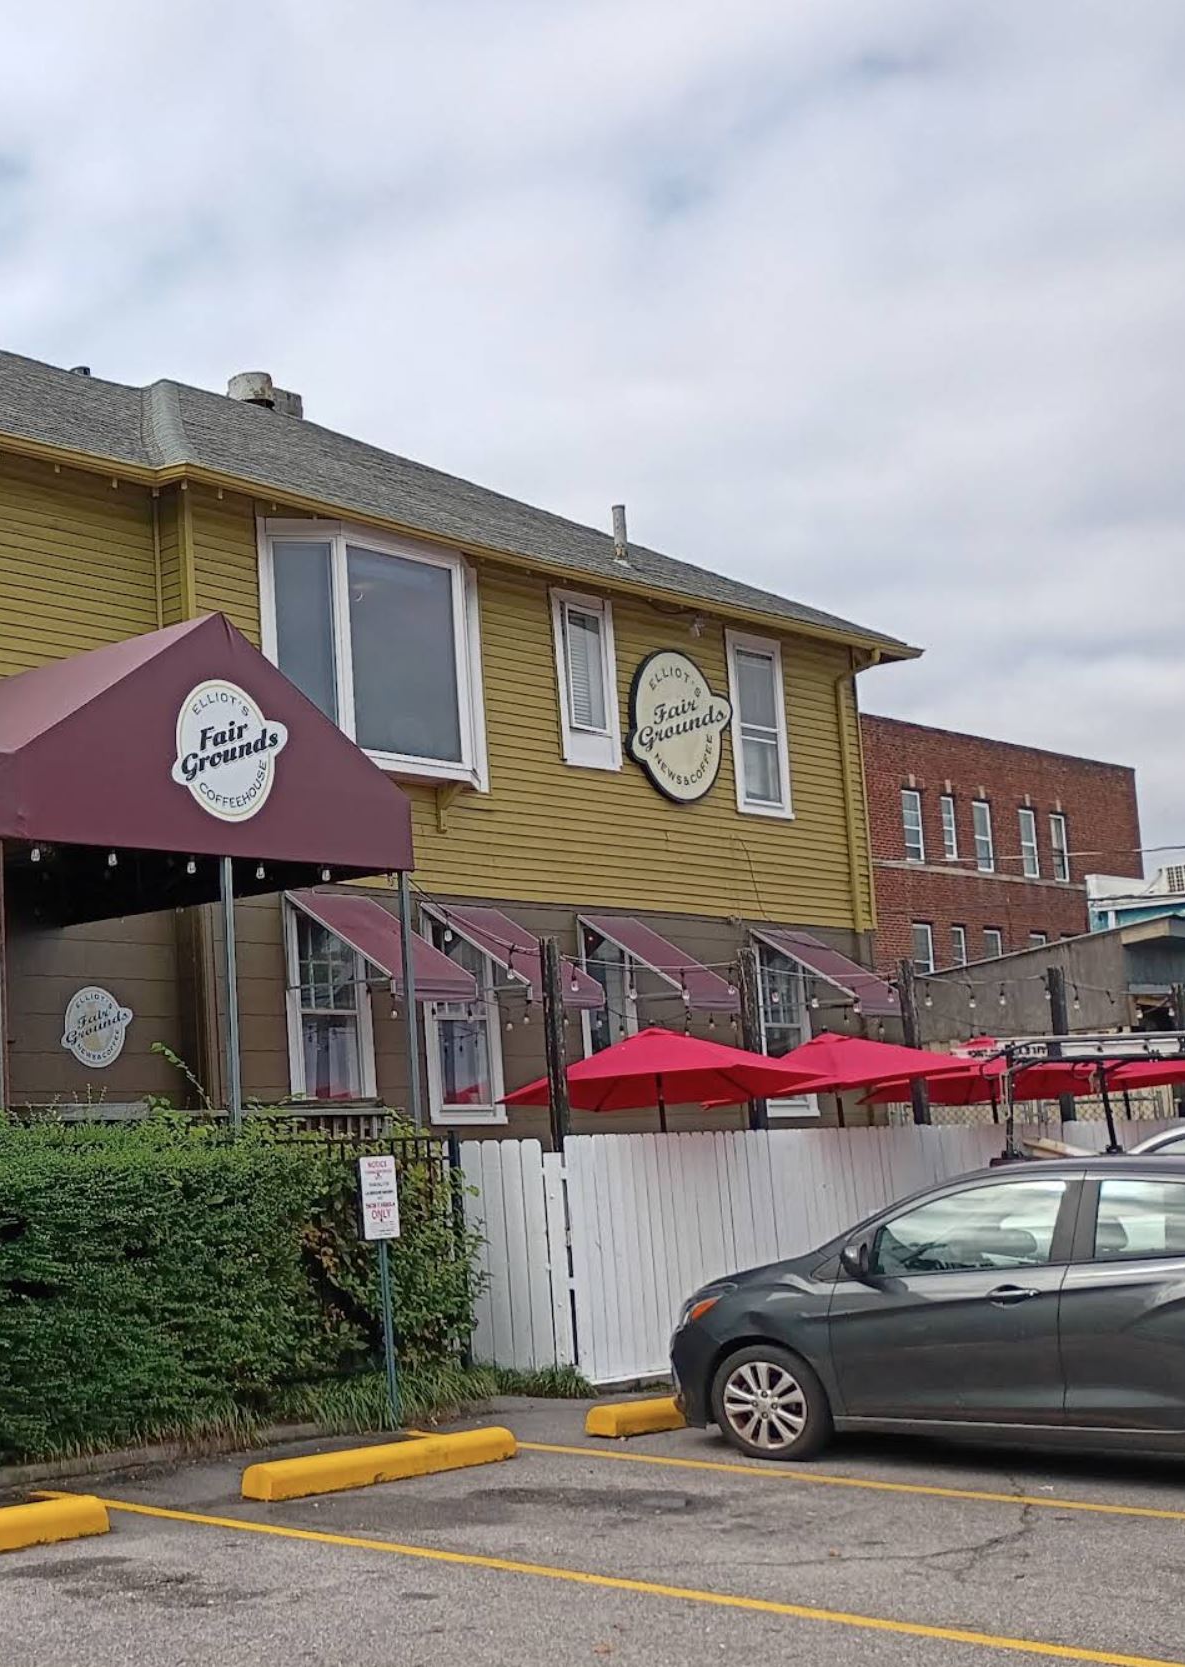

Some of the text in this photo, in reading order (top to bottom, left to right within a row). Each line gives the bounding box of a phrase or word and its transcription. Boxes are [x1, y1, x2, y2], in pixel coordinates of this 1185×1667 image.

[192, 692, 250, 717] ELLIOT'S
[653, 698, 698, 725] Fair
[199, 720, 248, 751] Fair
[637, 704, 727, 753] Grounds
[181, 728, 279, 782] Grounds
[199, 759, 267, 808] COFFEEHOUSE
[371, 1208, 391, 1219] ONLY
